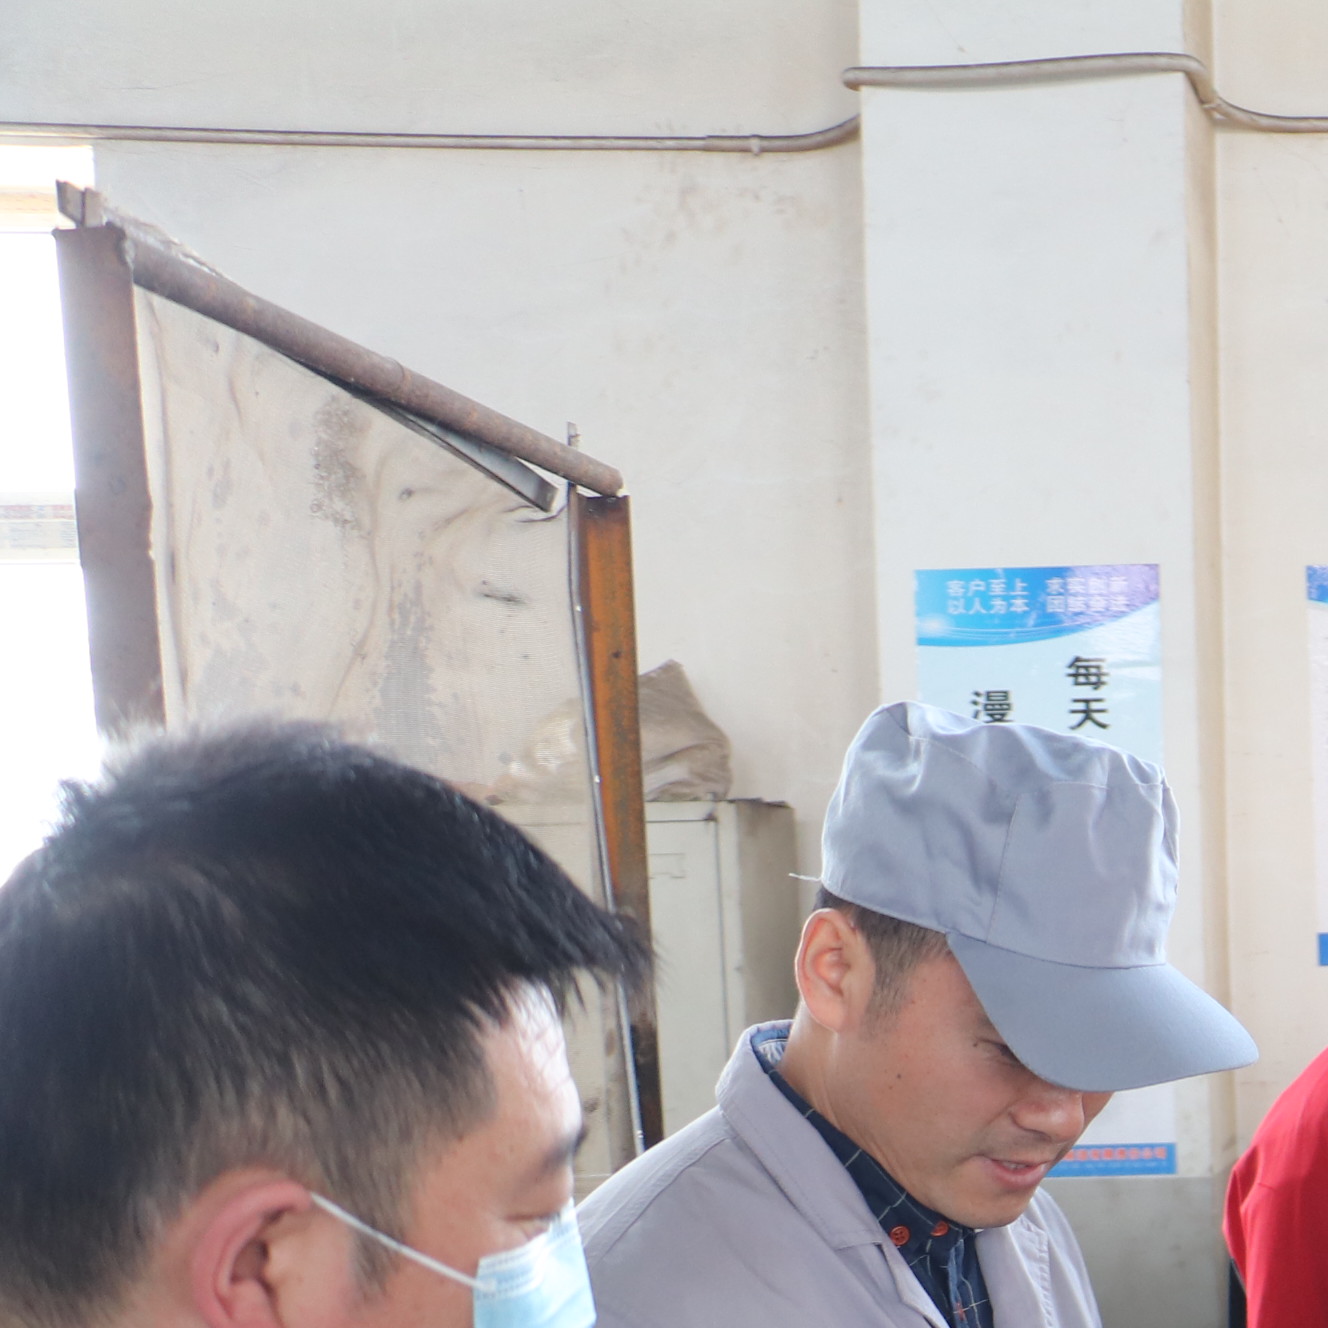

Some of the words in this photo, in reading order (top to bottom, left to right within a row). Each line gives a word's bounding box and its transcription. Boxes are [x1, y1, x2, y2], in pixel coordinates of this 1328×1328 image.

[946, 577, 1030, 597] 客户至上
[946, 597, 1030, 615] 以人为本
[1065, 655, 1111, 731] 每天
